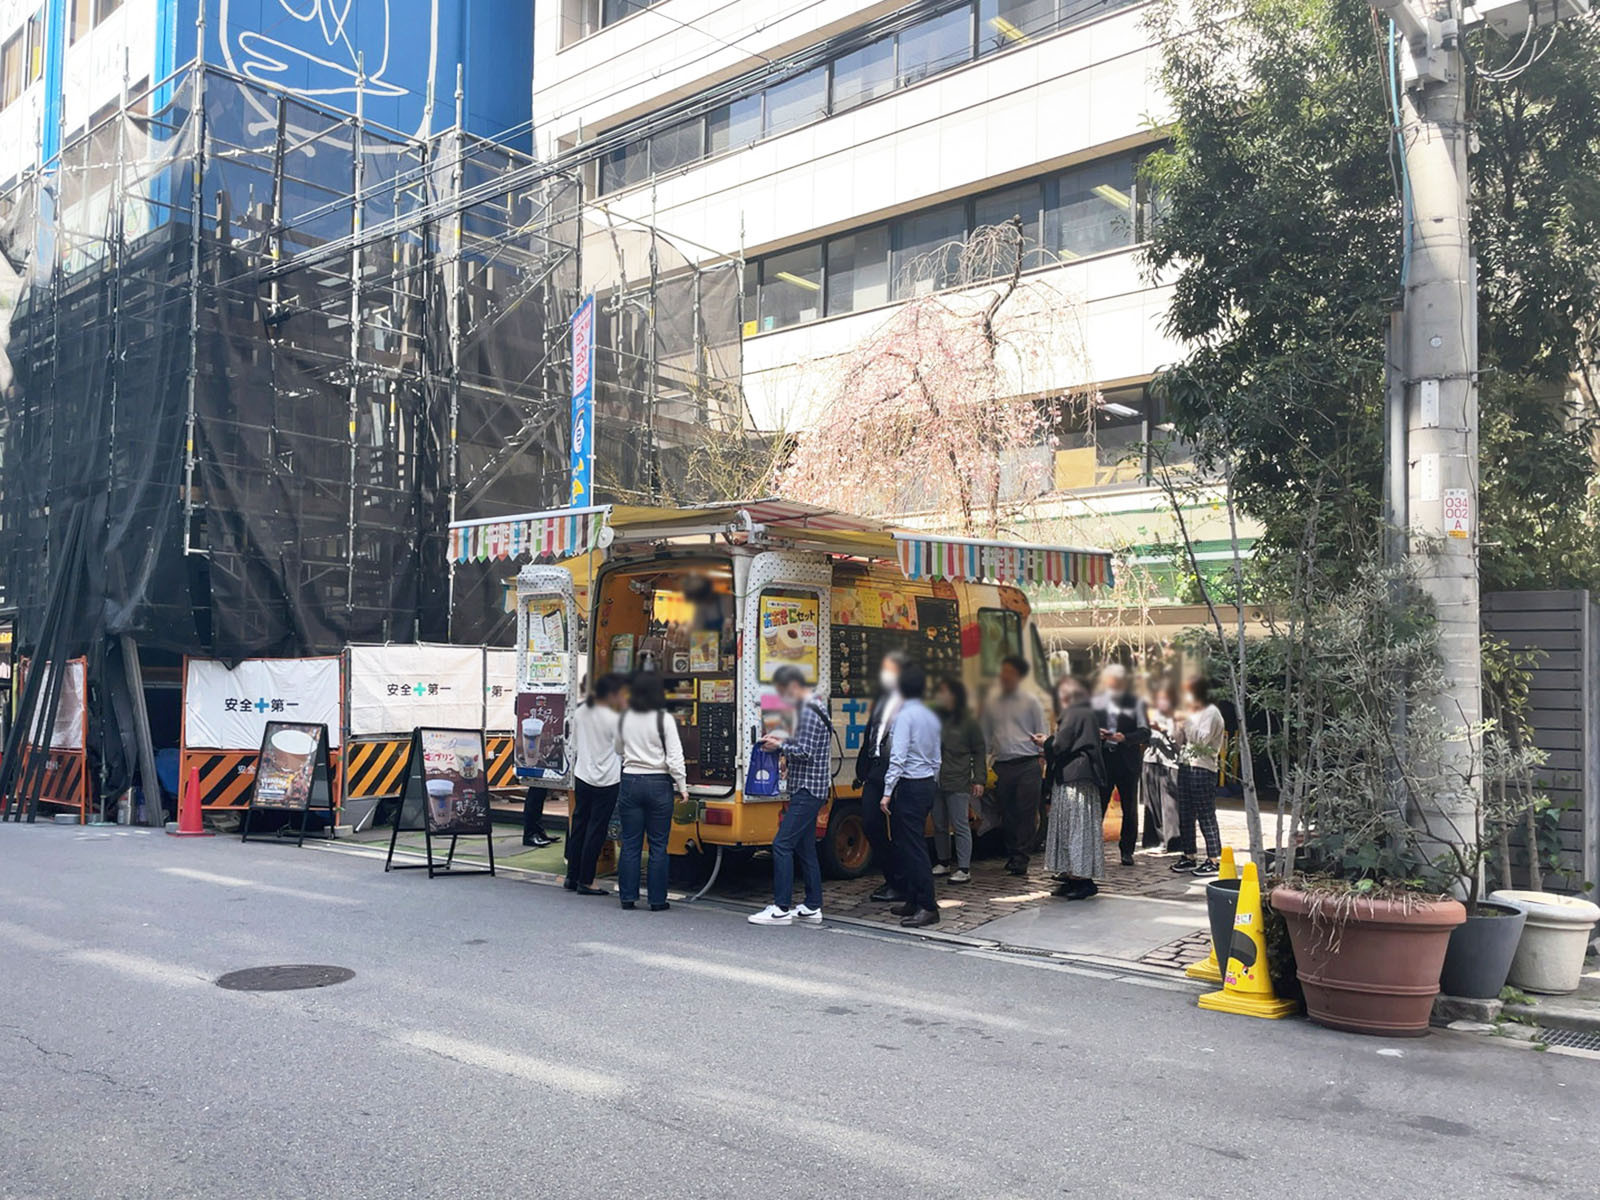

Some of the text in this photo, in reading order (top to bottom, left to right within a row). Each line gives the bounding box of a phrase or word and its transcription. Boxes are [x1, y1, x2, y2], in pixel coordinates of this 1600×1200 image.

[1446, 497, 1468, 507] 034
[1446, 508, 1468, 518] 002
[1454, 519, 1462, 529] A
[387, 684, 452, 696] 安全 第一
[491, 685, 513, 697] 第一
[224, 698, 299, 713] 安全 第一
